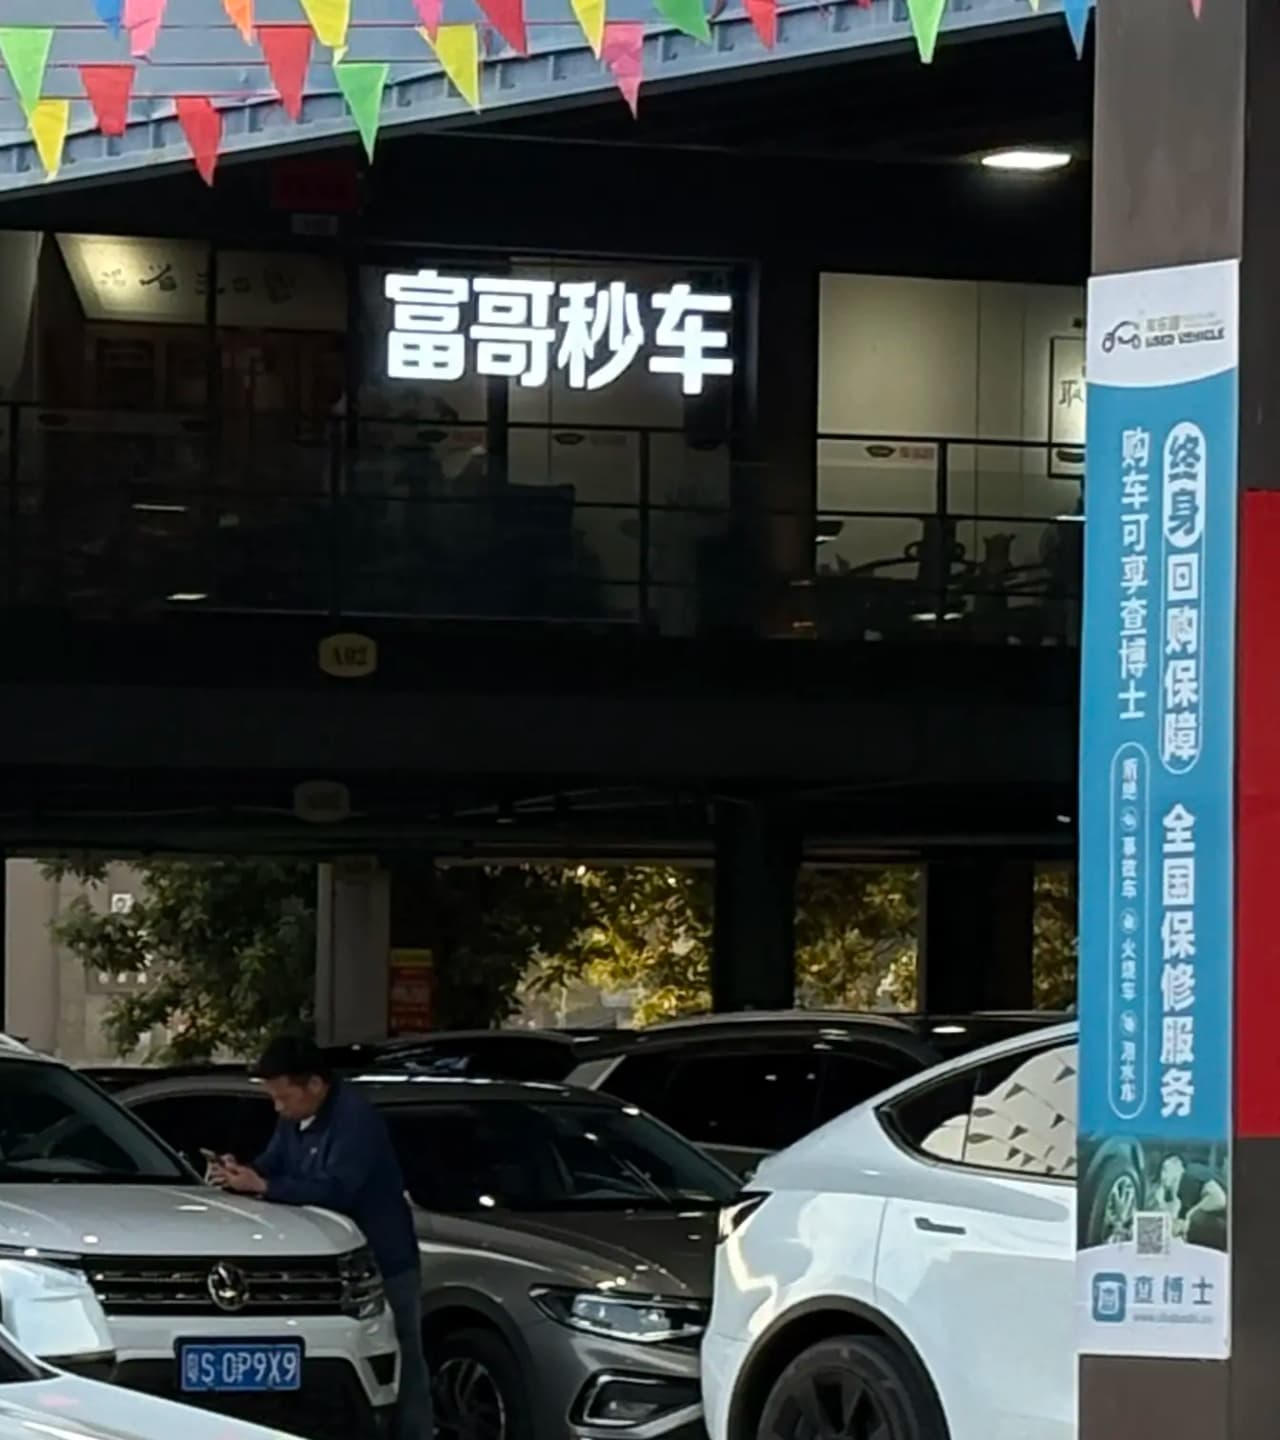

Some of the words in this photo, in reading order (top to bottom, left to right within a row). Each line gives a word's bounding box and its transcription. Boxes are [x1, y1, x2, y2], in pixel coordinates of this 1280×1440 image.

[385, 269, 734, 396] 富哥秒车
[1118, 426, 1150, 720] 购车可享查博士
[1163, 433, 1201, 763] 终身回购保障
[1159, 802, 1198, 1119] 全国保修服务
[1134, 1275, 1215, 1305] 查博士
